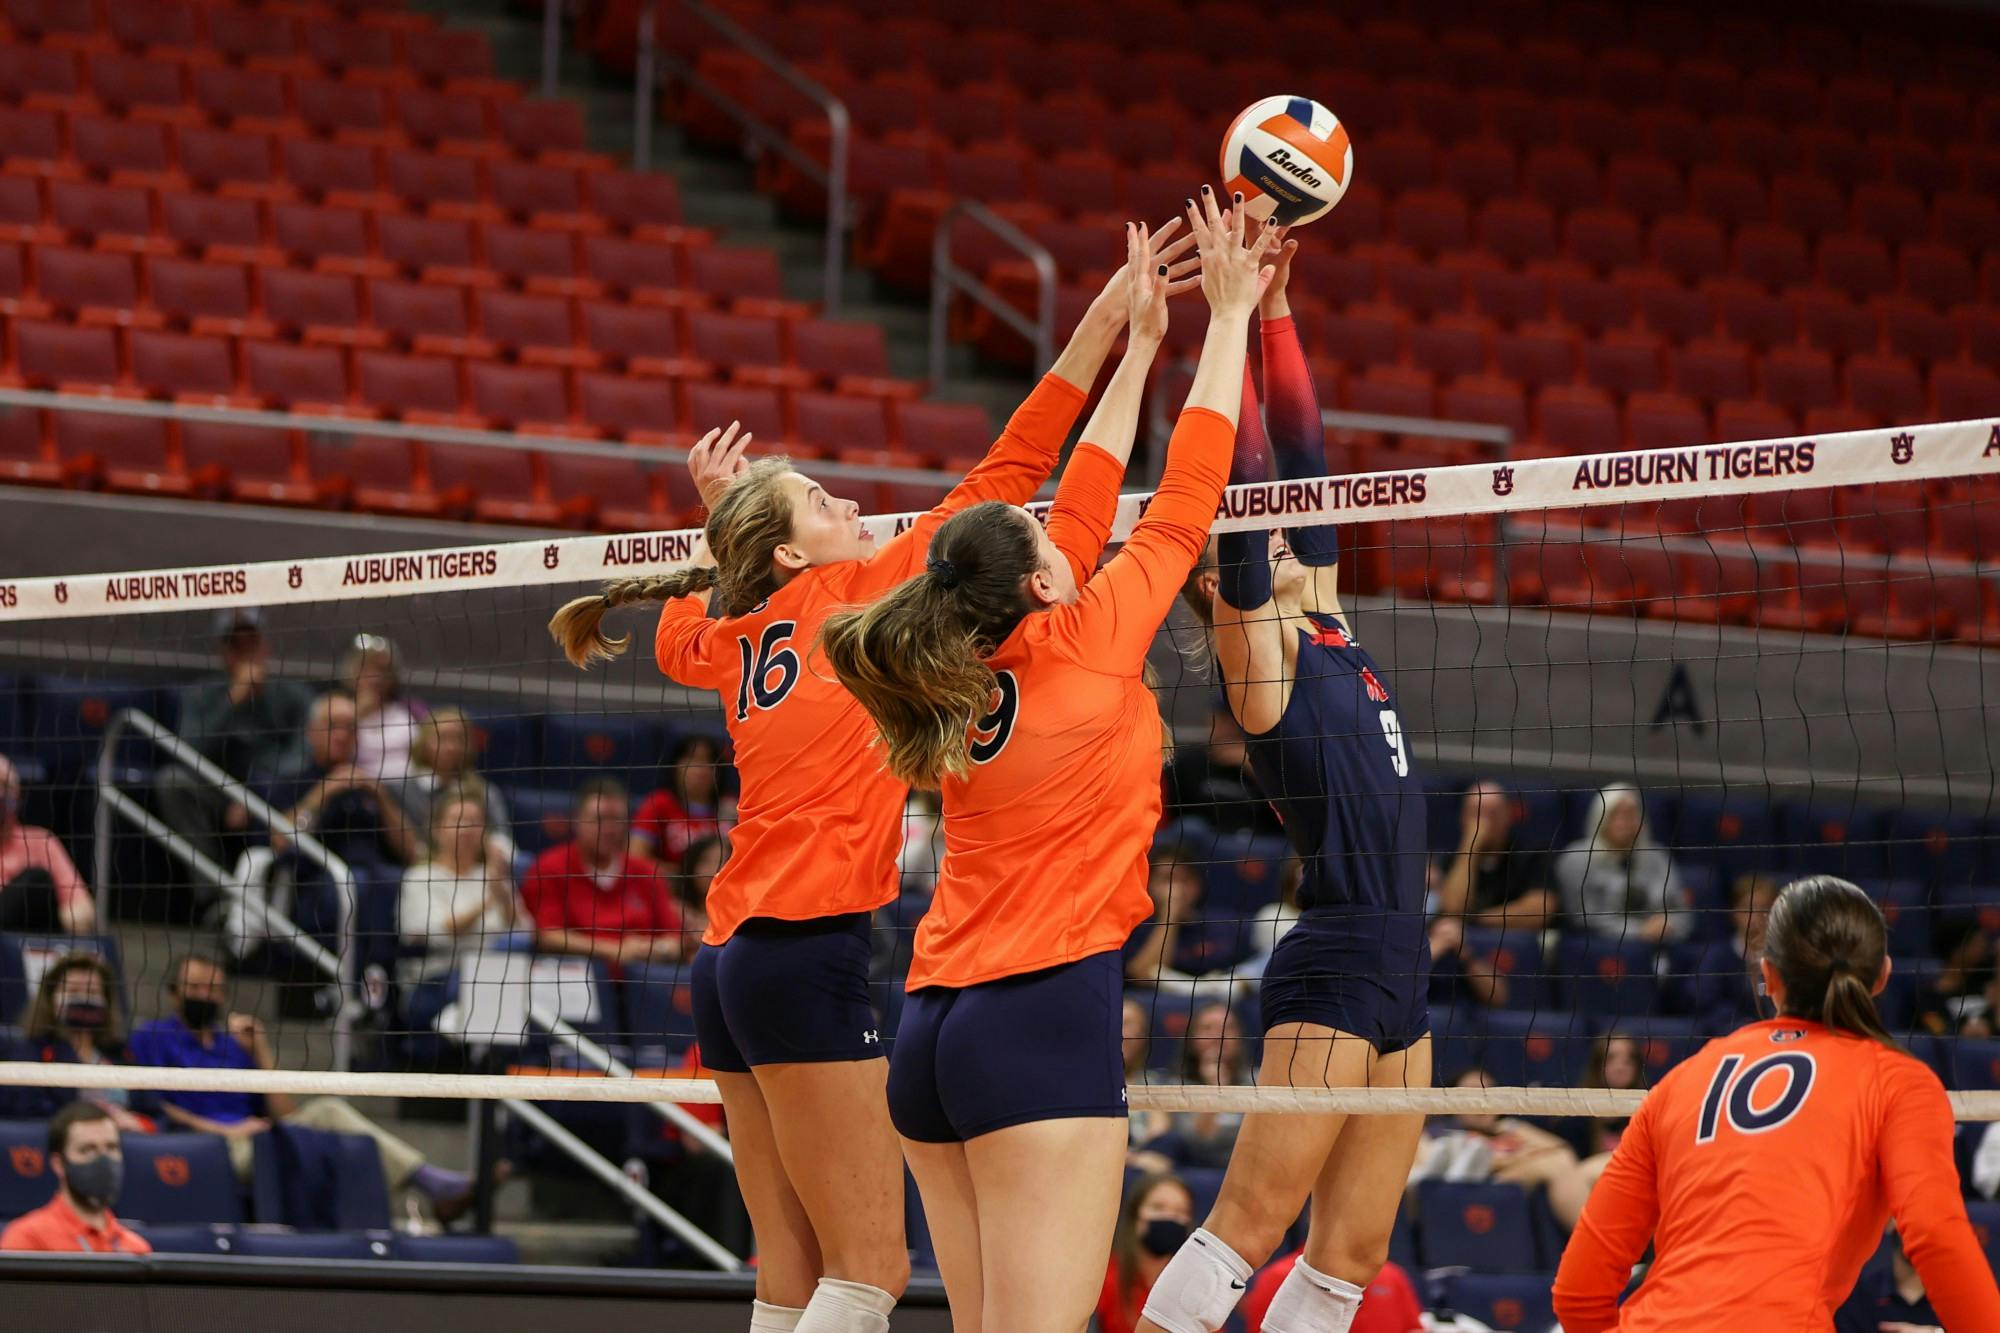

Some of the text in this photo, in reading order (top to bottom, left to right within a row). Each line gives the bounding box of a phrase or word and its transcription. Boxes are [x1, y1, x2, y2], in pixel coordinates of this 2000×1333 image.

[1266, 149, 1322, 189] Baden
[1572, 441, 1816, 490] AUBURN TIGERS
[1215, 473, 1427, 520] AUBURN TIGERS
[342, 550, 497, 586] AUBURN TIGERS
[603, 535, 693, 566] AUBURN
[106, 570, 247, 600] AUBURN TIGERS
[736, 620, 801, 723] 16
[966, 669, 1020, 765] 9
[1649, 662, 1704, 737] A
[1379, 709, 1409, 777] 9
[1695, 1050, 1817, 1146] 10
